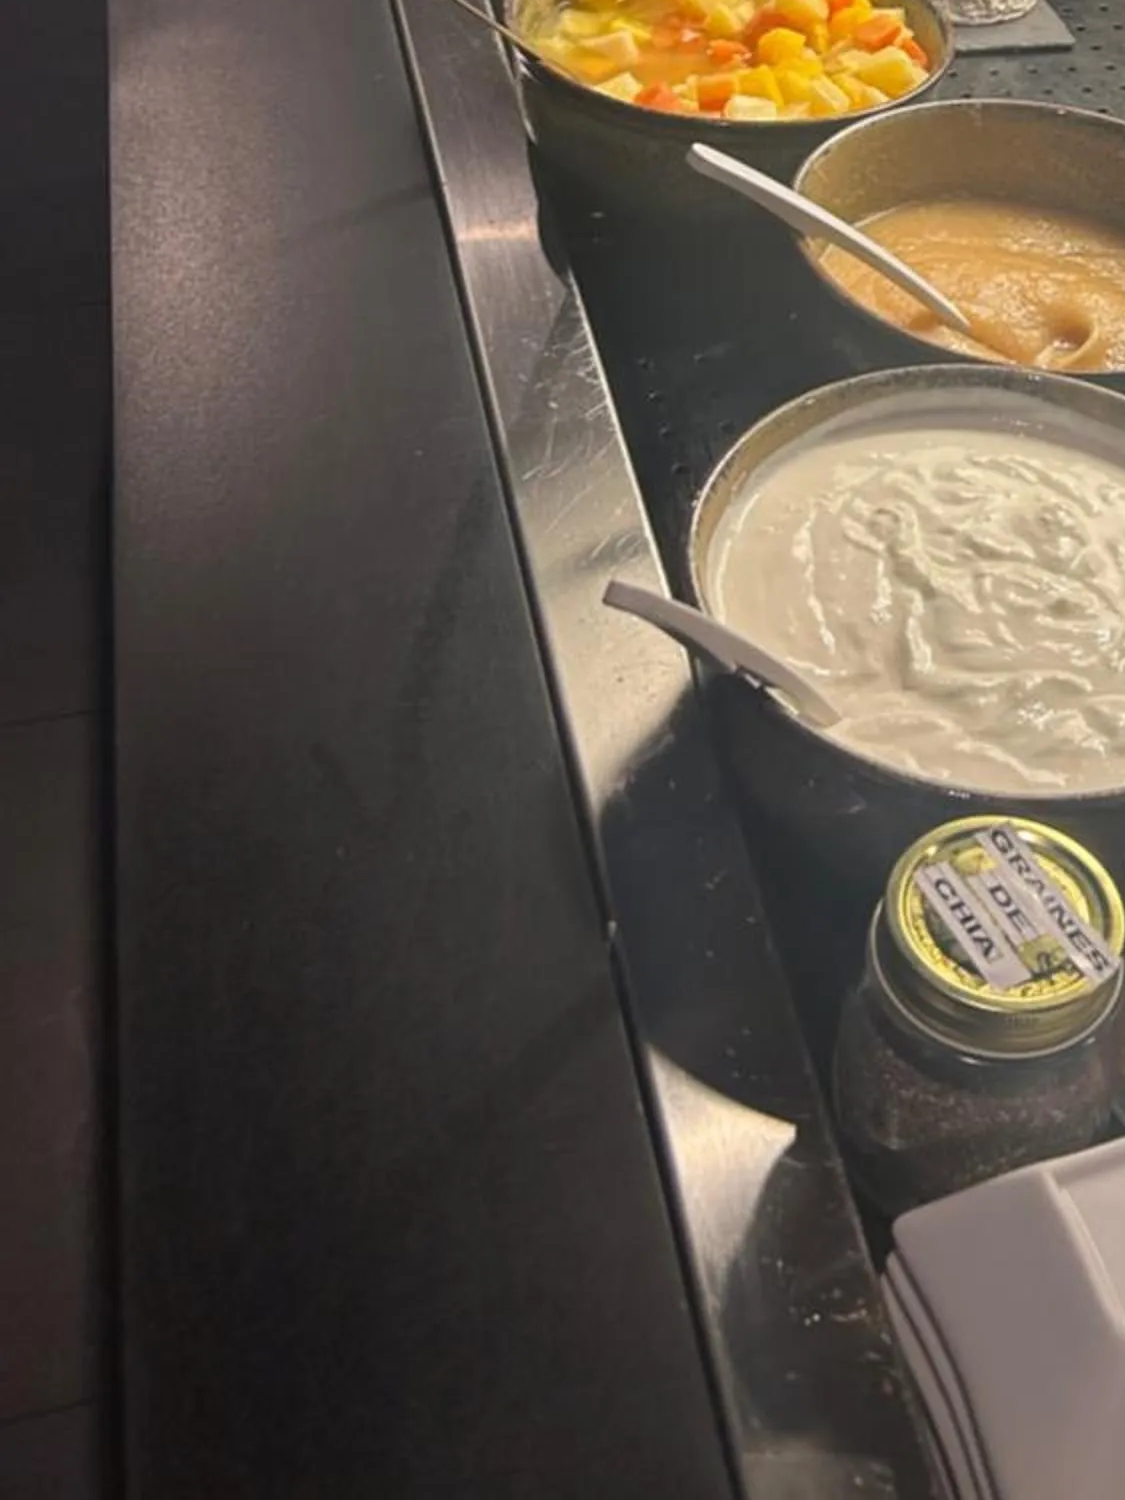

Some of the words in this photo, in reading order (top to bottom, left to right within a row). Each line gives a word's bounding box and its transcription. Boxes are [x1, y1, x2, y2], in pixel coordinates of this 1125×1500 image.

[934, 877, 998, 959] CHIA
[989, 883, 1032, 933] DE
[991, 828, 1112, 972] GRAINES
